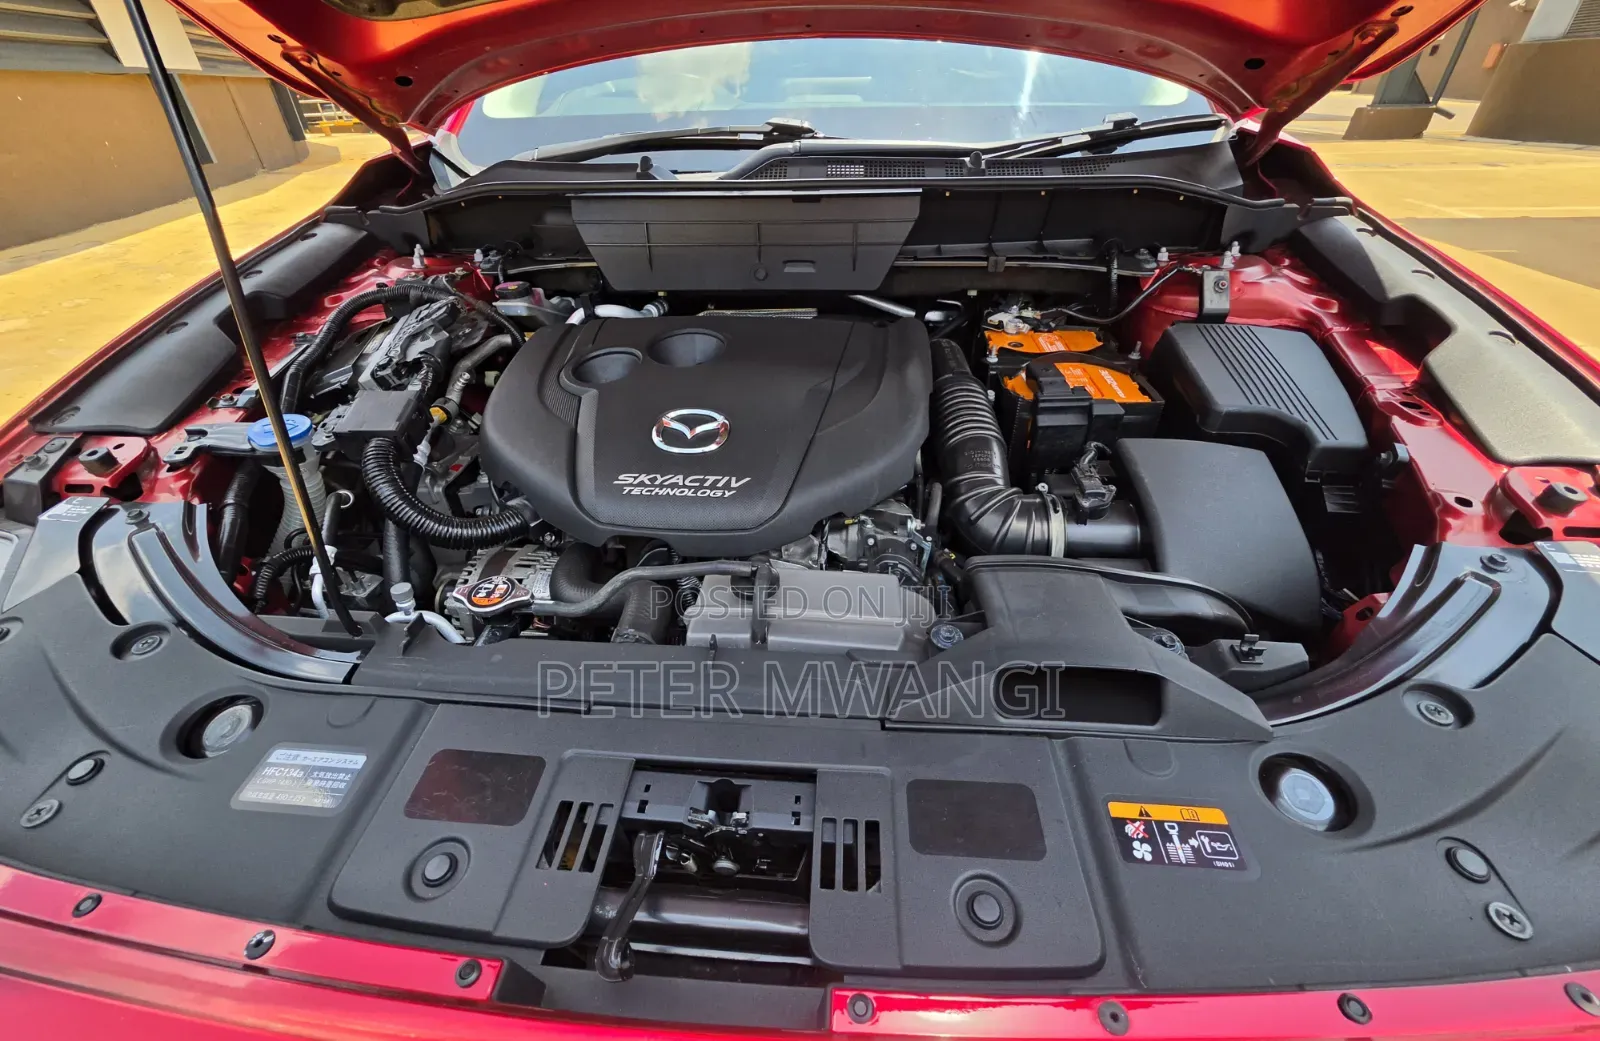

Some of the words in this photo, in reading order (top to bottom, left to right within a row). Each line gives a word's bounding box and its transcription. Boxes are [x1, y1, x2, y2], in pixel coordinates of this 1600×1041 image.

[613, 473, 752, 488] SKYACTIV
[622, 486, 737, 498] TECHNOLOGY
[261, 766, 304, 778] HFC134a
